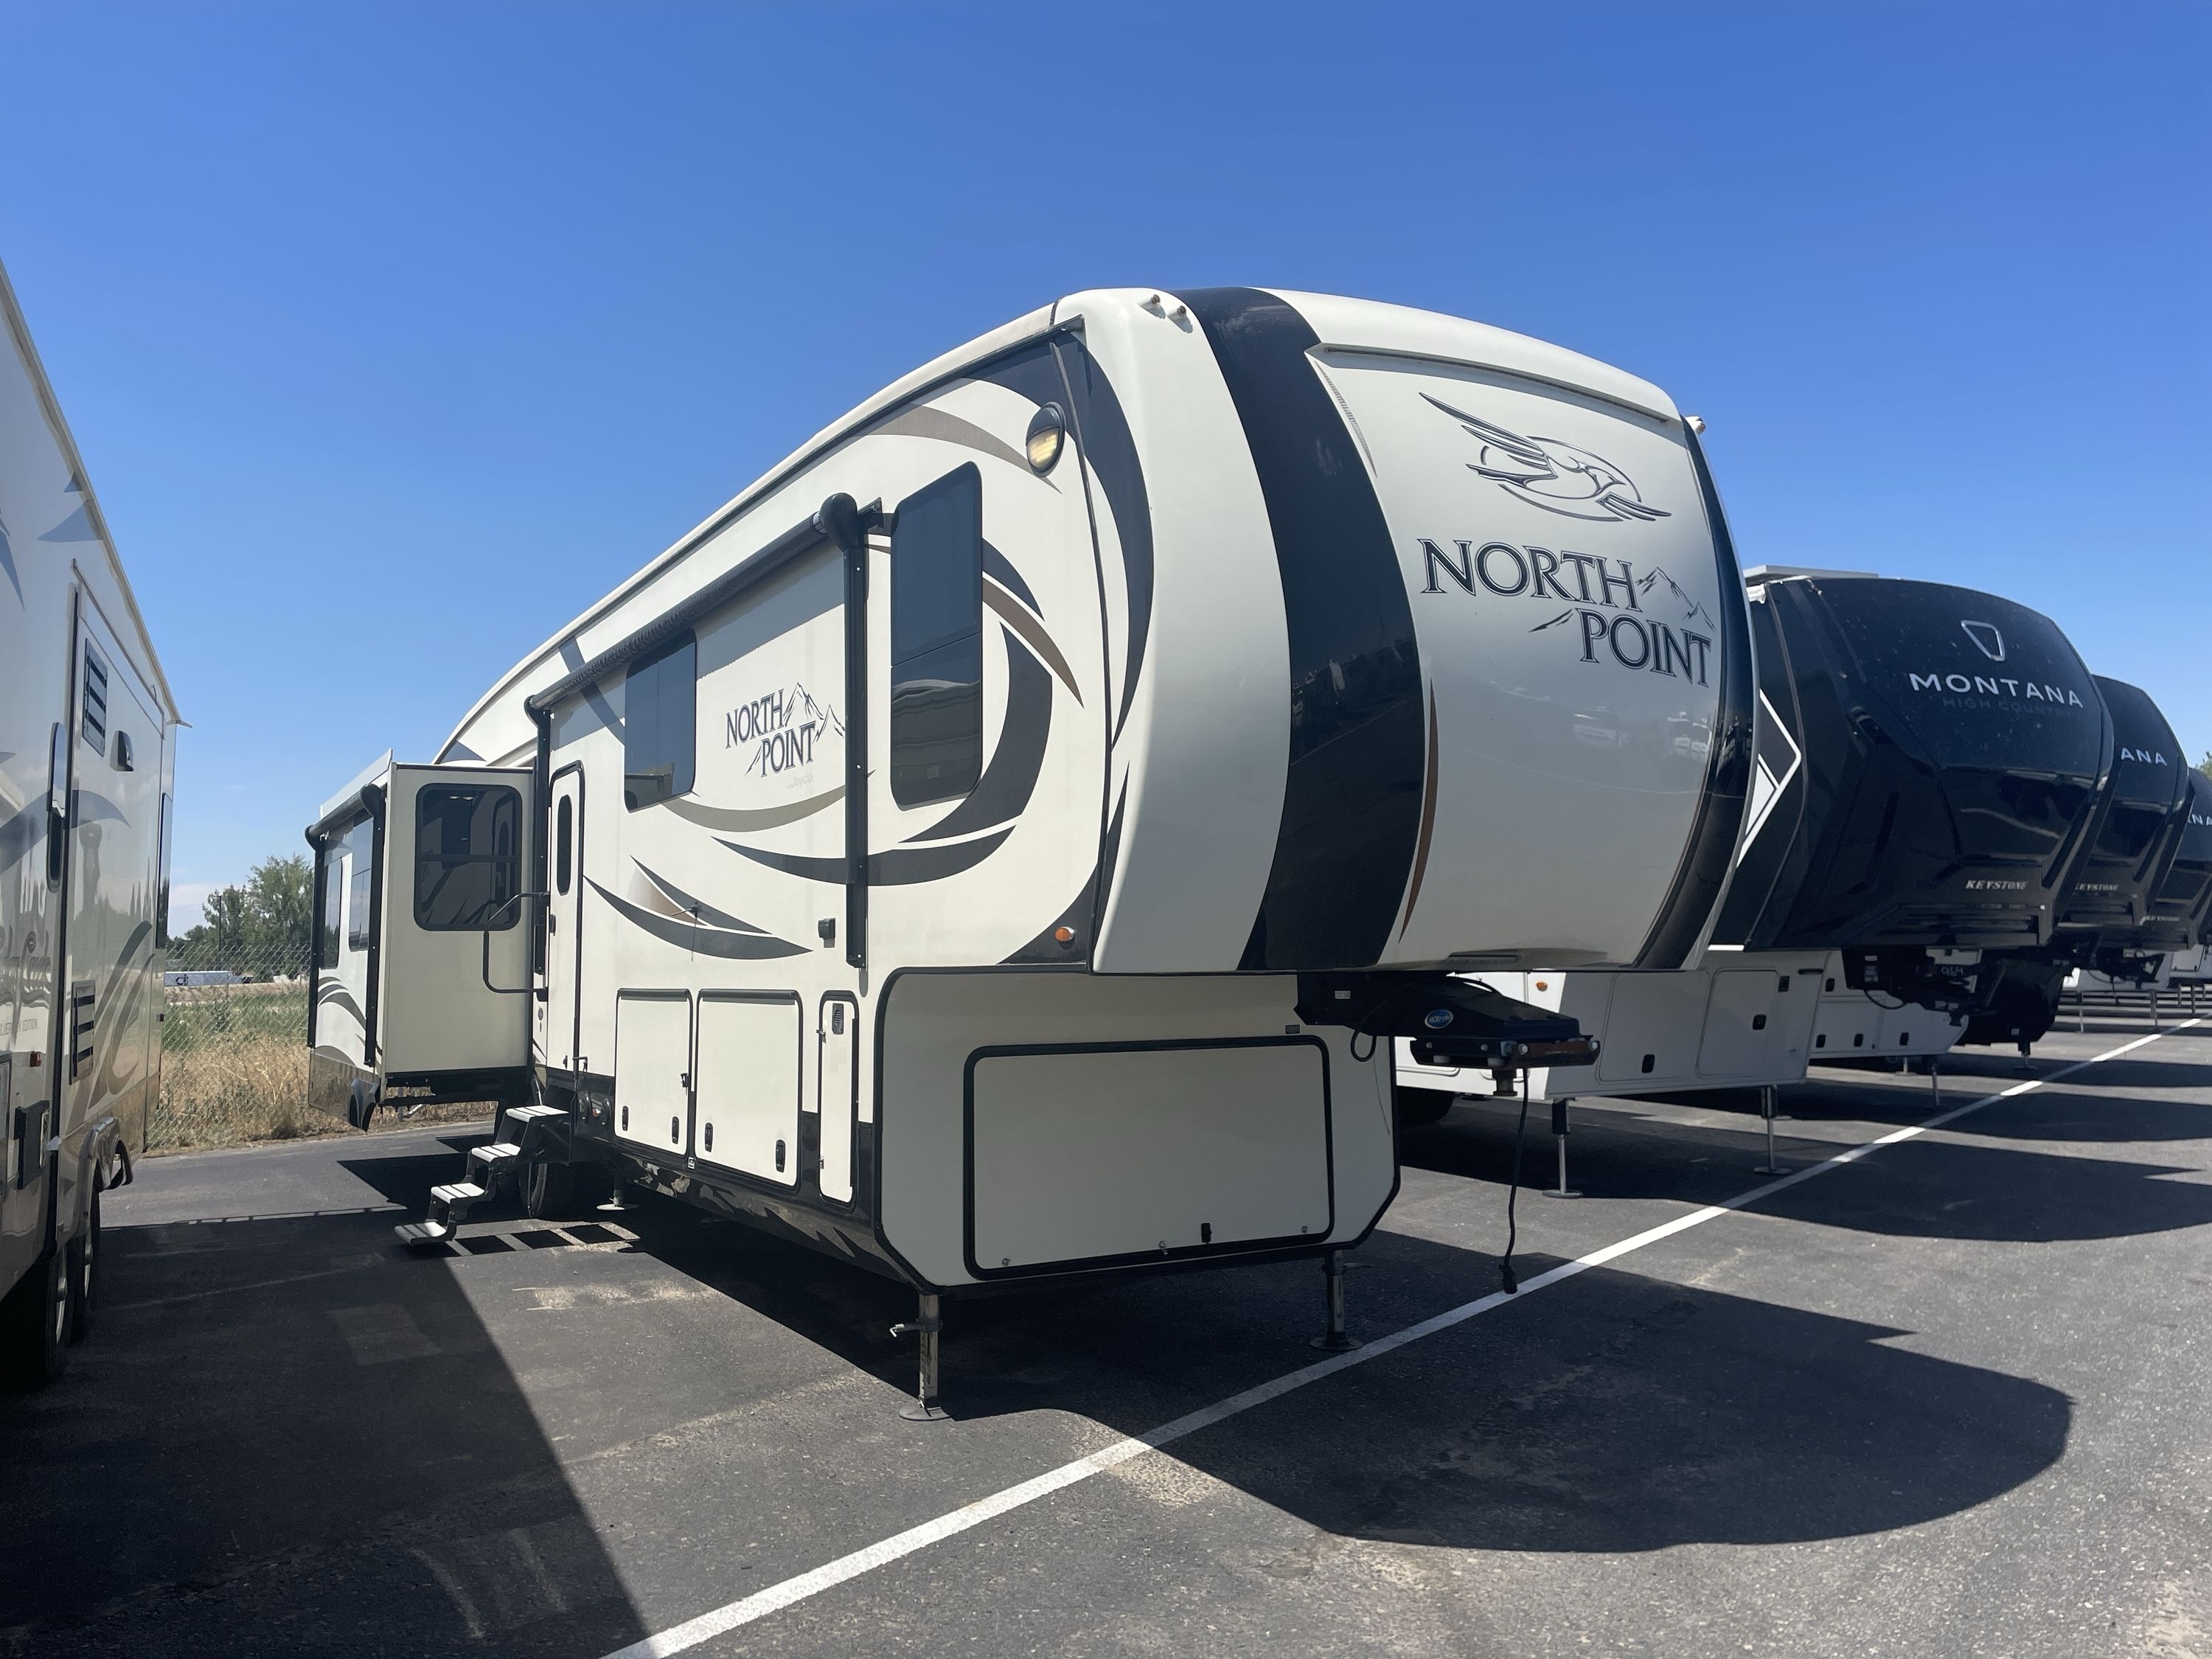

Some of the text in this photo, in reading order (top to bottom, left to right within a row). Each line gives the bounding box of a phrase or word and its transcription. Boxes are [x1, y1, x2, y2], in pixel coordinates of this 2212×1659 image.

[1416, 538, 1644, 612] NORTH
[1575, 608, 1713, 688] POINT
[725, 688, 785, 749] NORTH
[1909, 672, 2084, 709] MONTANA
[760, 720, 817, 778] POINT
[2121, 747, 2168, 767] ANA
[1965, 880, 2029, 891] KEYSTONE
